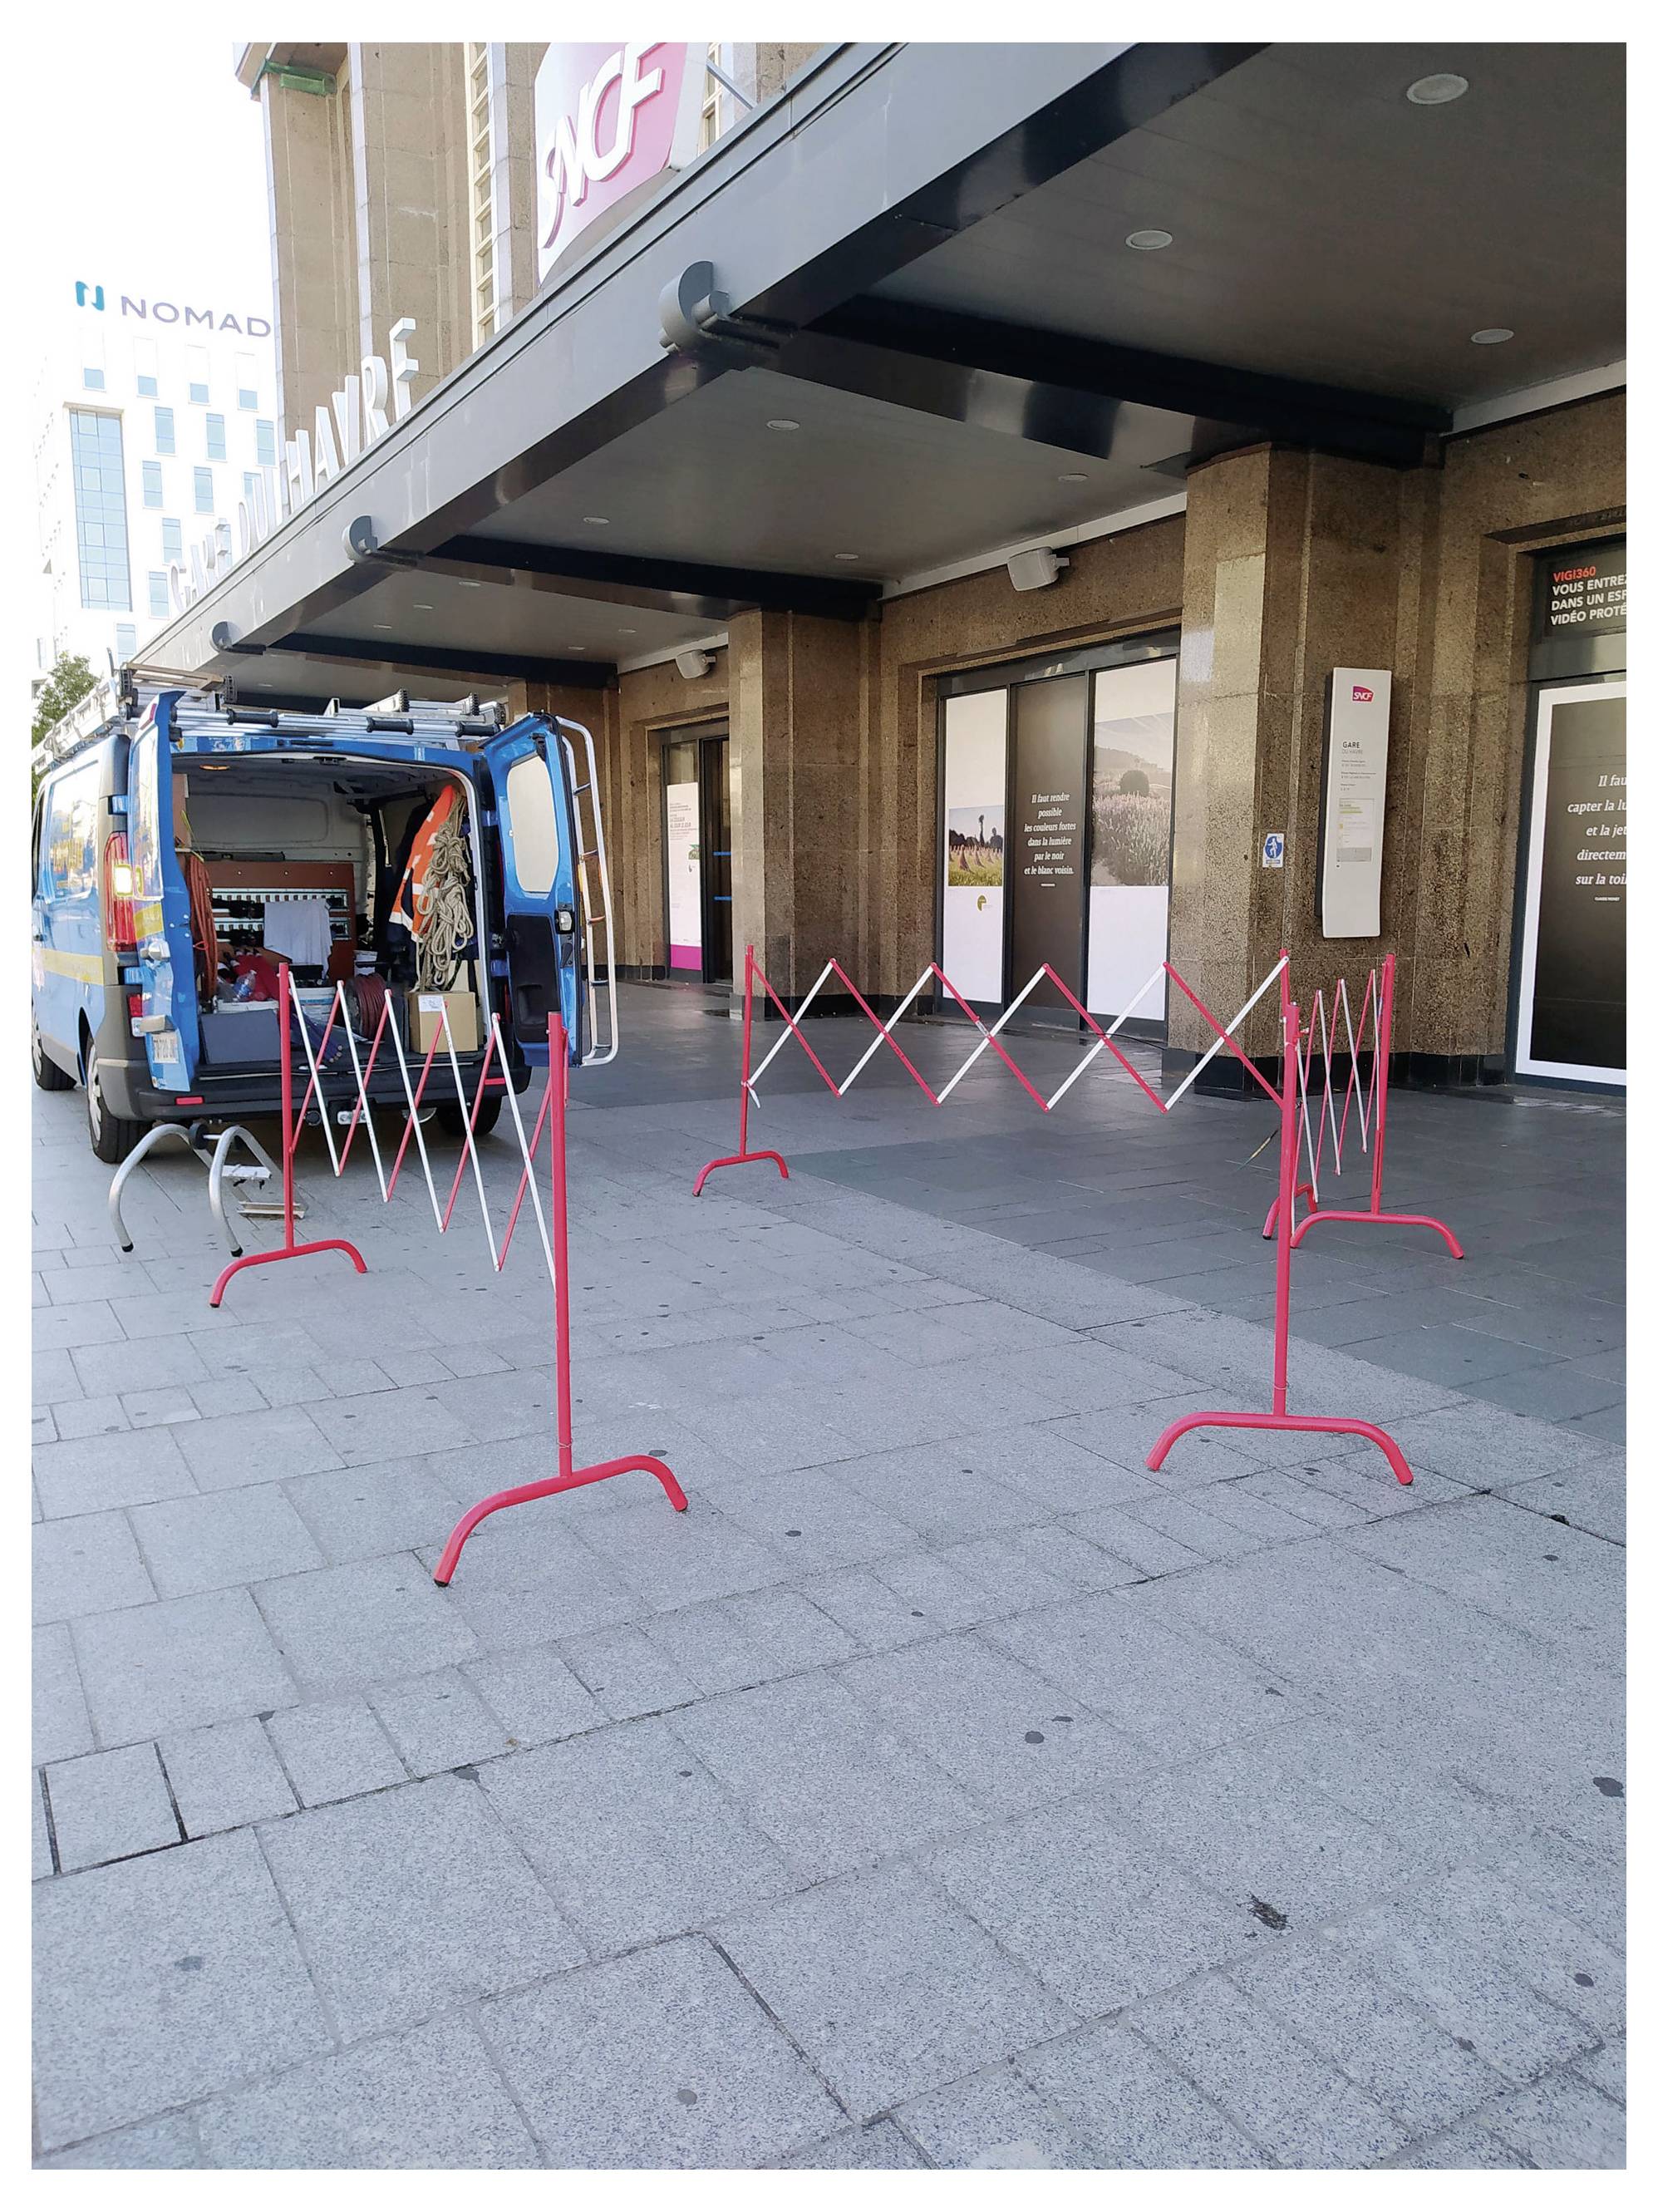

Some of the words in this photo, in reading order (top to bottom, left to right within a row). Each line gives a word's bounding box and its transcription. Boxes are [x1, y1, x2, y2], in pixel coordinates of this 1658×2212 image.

[537, 42, 665, 249] SNCF
[121, 296, 271, 337] NOMAD
[285, 318, 419, 515] HAVRE
[1553, 566, 1596, 583] VIGI360
[1552, 581, 1584, 596] VOUS
[1551, 596, 1584, 611] DANS
[1587, 593, 1604, 606] UN
[1551, 609, 1587, 626] VIDÉO
[1589, 602, 1626, 620] PROTÉ
[1354, 692, 1372, 700] SNCF
[1342, 741, 1360, 749] GARE
[1598, 774, 1607, 787] Il
[1031, 794, 1037, 804] Il
[1037, 793, 1050, 803] faut
[1050, 792, 1070, 802] rendre
[1038, 807, 1062, 819] possible
[1567, 802, 1602, 815] capter
[1604, 799, 1615, 811] la
[1024, 823, 1032, 832] les
[1033, 822, 1058, 832] couleurs
[1059, 821, 1076, 831] fortes
[1586, 825, 1597, 836] et
[1599, 824, 1610, 836] la
[1027, 837, 1041, 846] dans
[1042, 837, 1048, 846] la
[1049, 836, 1072, 845] lumière
[1034, 853, 1045, 863] par
[1045, 851, 1050, 860] le
[1051, 850, 1065, 860] noir
[1577, 849, 1626, 861] directem
[1024, 866, 1031, 874] et
[1031, 865, 1037, 874] le
[1037, 865, 1053, 874] blanc
[1576, 874, 1593, 885] sur
[1595, 873, 1606, 885] la
